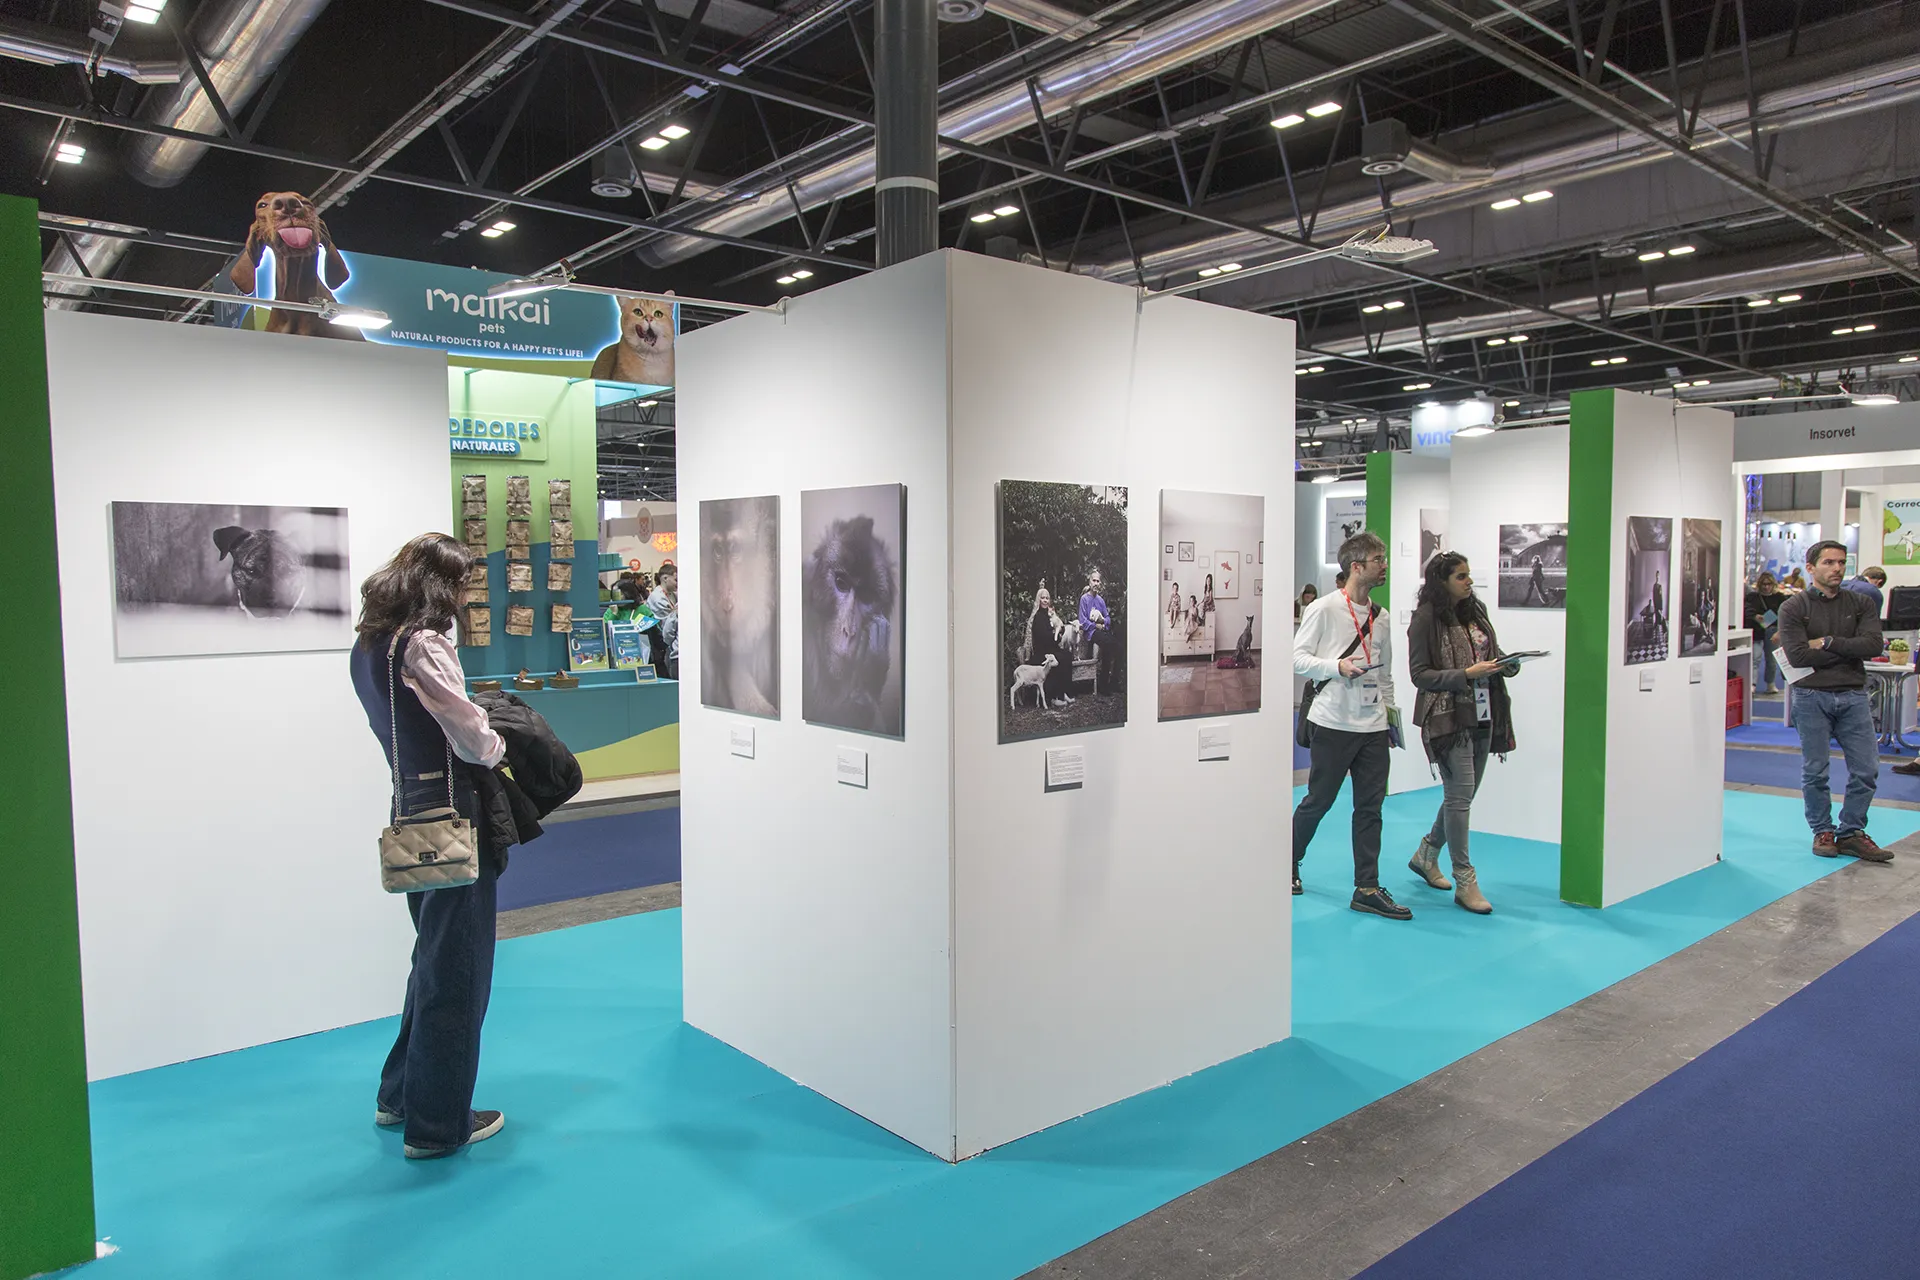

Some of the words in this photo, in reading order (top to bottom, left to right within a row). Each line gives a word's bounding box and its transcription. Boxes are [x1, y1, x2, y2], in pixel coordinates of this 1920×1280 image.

[479, 322, 506, 334] pets
[391, 330, 434, 343] NATURAL
[436, 334, 482, 348] PRODUCTS
[484, 340, 502, 350] FOR
[503, 342, 511, 351] A
[512, 343, 541, 354] HAPPY
[542, 346, 564, 357] PET'S
[565, 349, 584, 359] LIFE!
[448, 418, 540, 440] DEDORES
[1809, 426, 1856, 441] Insorvet
[452, 440, 517, 453] NATURALES
